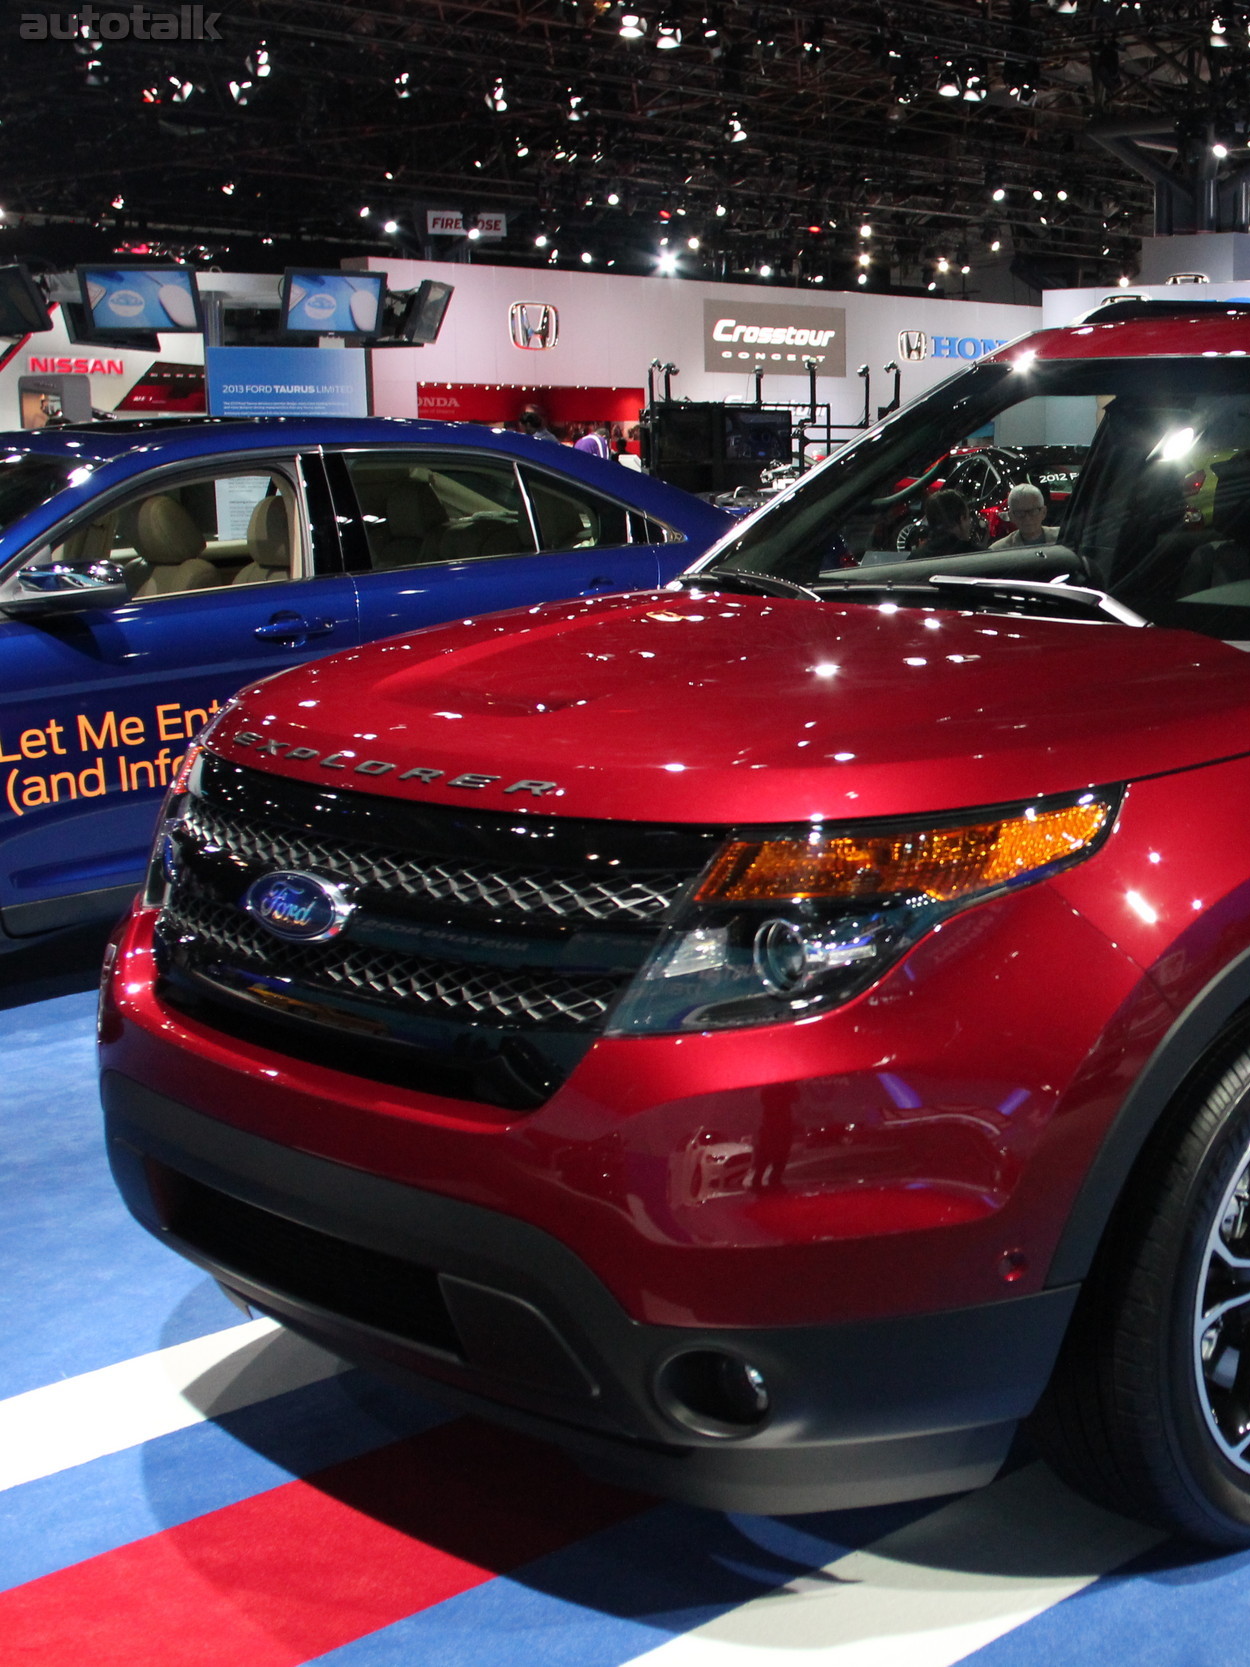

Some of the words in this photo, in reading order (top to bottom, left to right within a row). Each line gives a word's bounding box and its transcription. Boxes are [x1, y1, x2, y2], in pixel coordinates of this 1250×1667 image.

[432, 217, 463, 230] FIRE
[477, 219, 502, 231] OSE
[712, 318, 836, 347] Crosstour
[721, 350, 826, 363] CONCEPT
[29, 357, 124, 375] NISSAN
[222, 384, 244, 394] 2013
[245, 384, 273, 394] FORD
[273, 384, 315, 394] TAURUS
[315, 384, 354, 394] LIMITED
[1038, 472, 1068, 484] 2012
[0, 718, 67, 764] Let
[77, 710, 146, 752] Me
[232, 731, 558, 797] EXPLORER
[6, 756, 107, 817] (and
